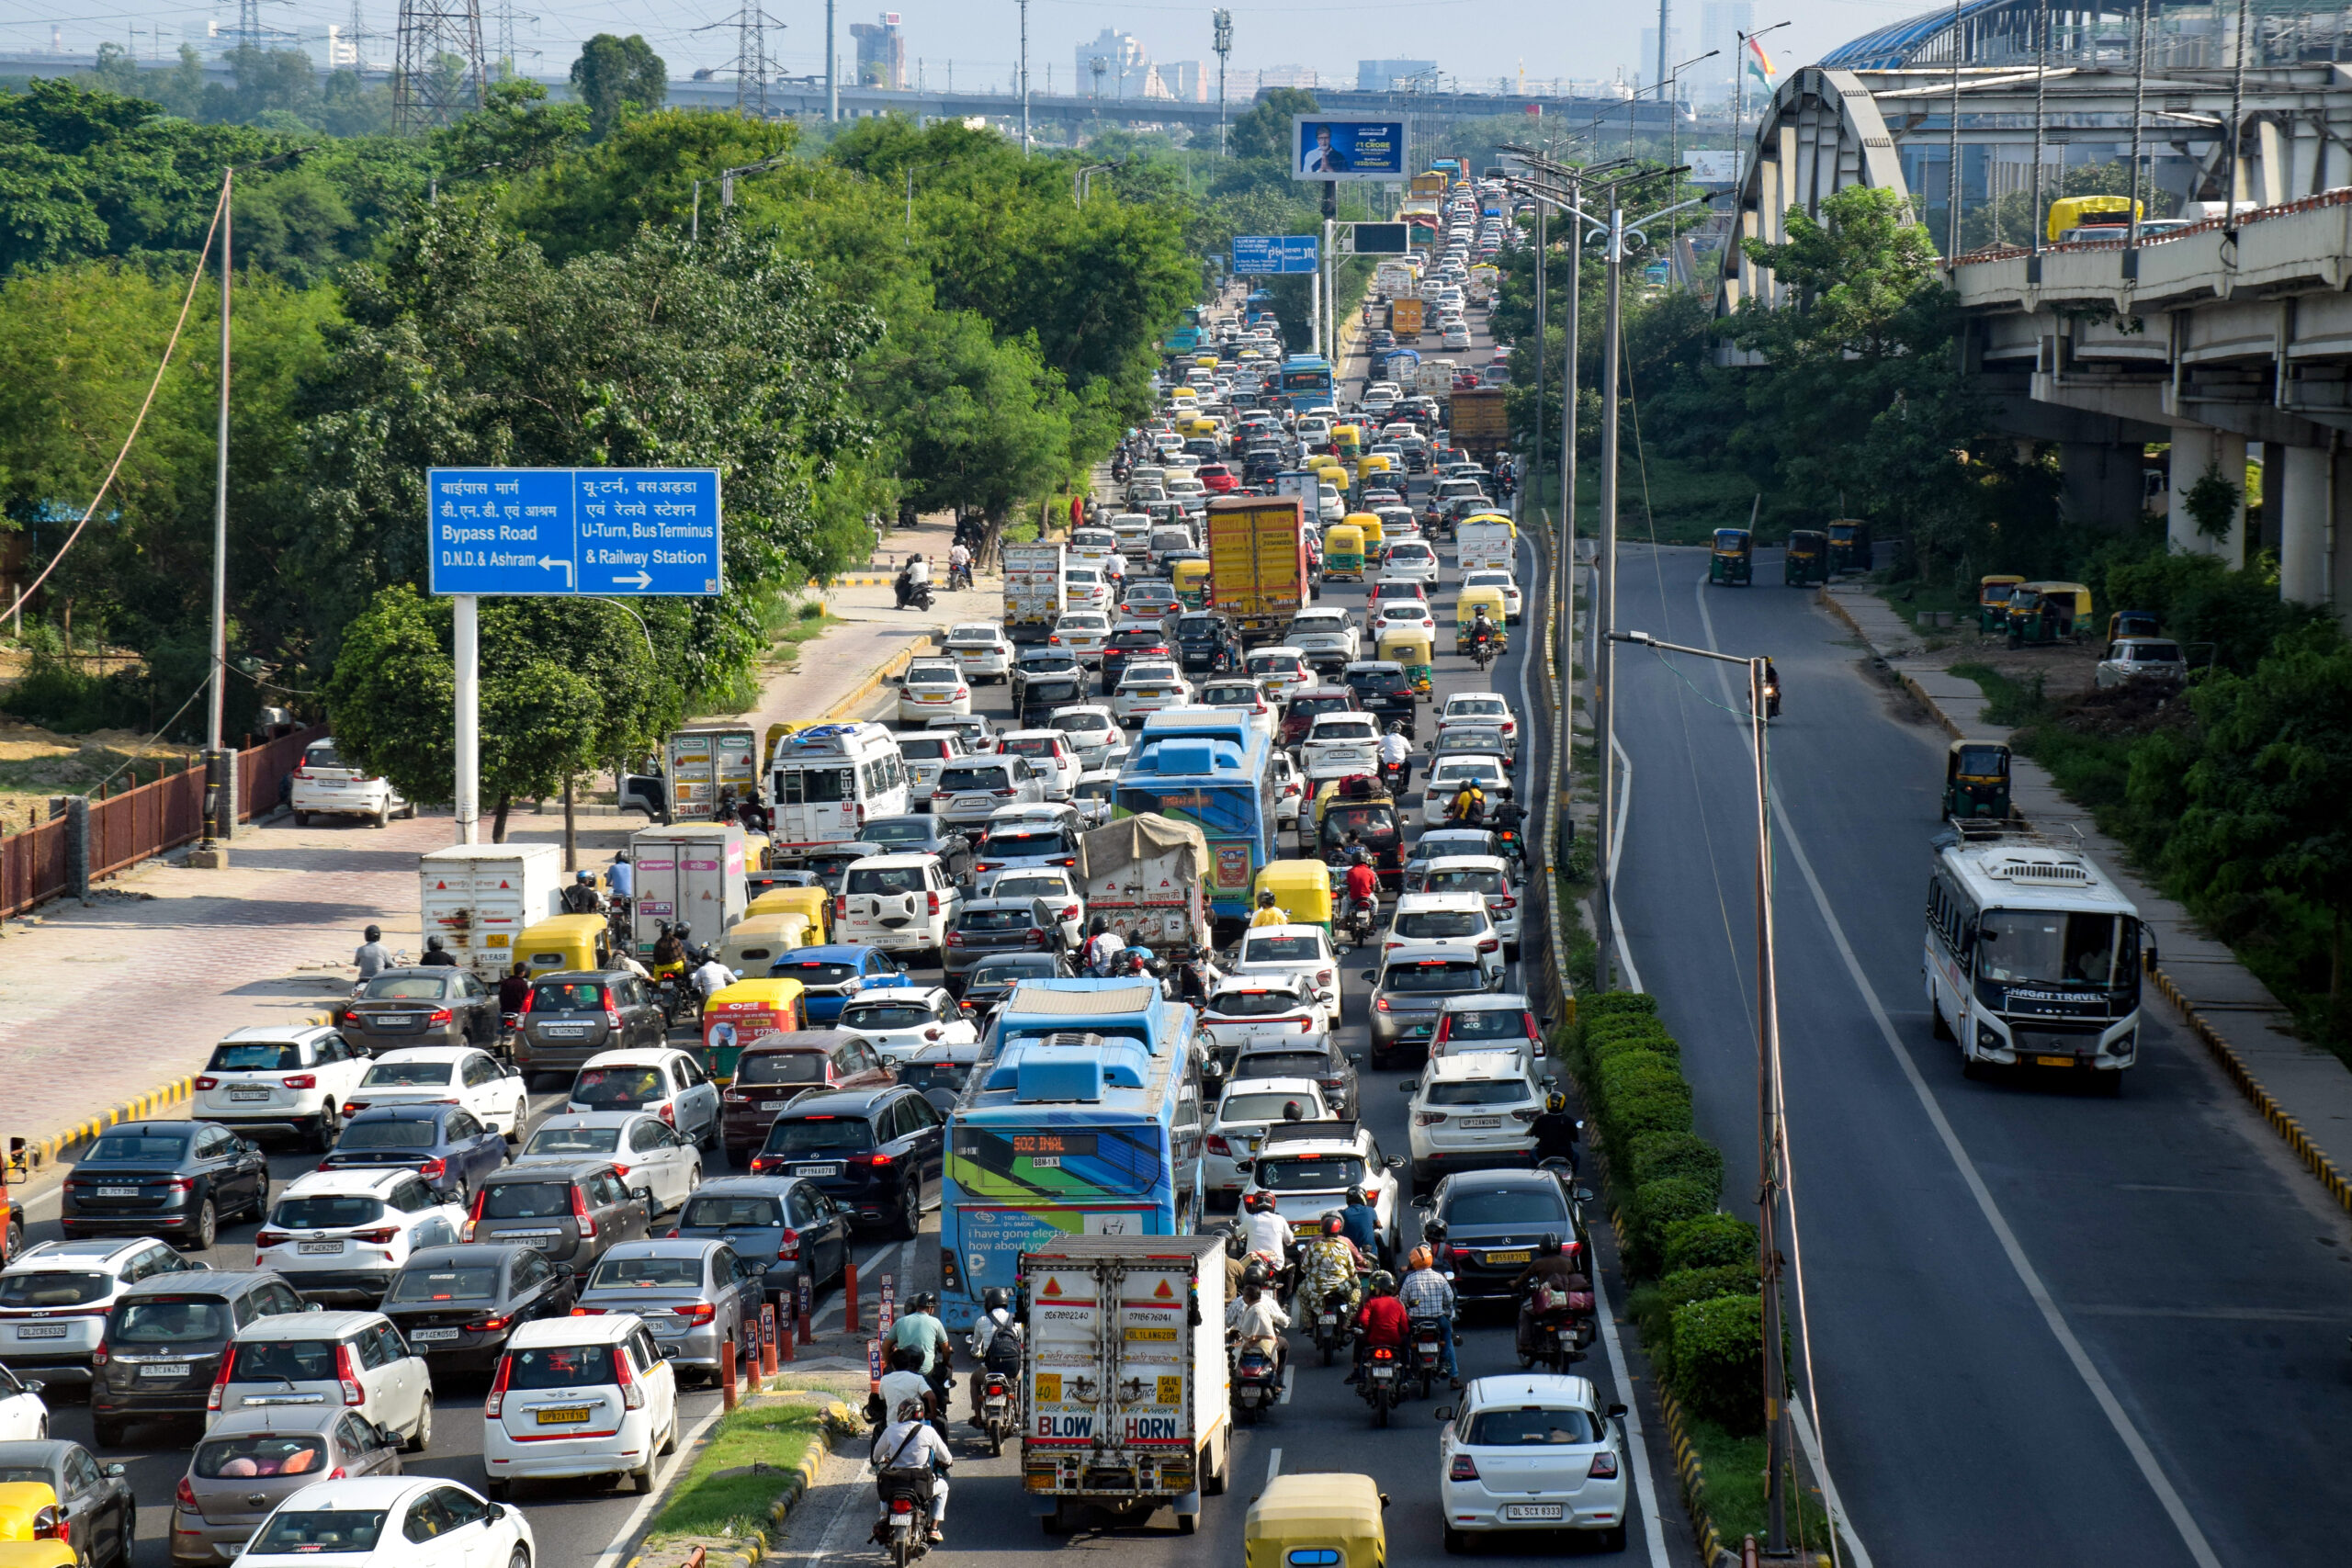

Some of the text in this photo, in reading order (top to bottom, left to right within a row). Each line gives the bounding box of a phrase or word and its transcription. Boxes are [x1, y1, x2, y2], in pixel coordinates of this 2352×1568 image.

[441, 479, 519, 496] बाईपास मार्ग
[504, 501, 520, 520] एवं
[525, 505, 557, 518] आश्रम
[585, 501, 696, 518] एवं रेलवे स्टेशन
[442, 525, 537, 543] Bypass Road
[582, 523, 713, 540] U-Turn, Bus Terminus
[491, 551, 536, 566] Ashram
[586, 549, 706, 568] & Railway Station
[679, 804, 711, 815] BLOW
[1013, 1136, 1035, 1151] 502
[968, 1229, 971, 1238] i
[974, 1230, 1000, 1238] have
[1002, 1232, 1029, 1240] gone
[969, 1241, 992, 1250] how
[995, 1241, 1026, 1250] about
[747, 1332, 756, 1358] PWD
[871, 1351, 880, 1377] PWD
[1036, 1387, 1051, 1398] 40
[1159, 1394, 1180, 1403] 6209
[1038, 1416, 1176, 1439] BLOW HORN
[1513, 1508, 1522, 1516] DL
[1542, 1507, 1560, 1516] 8333
